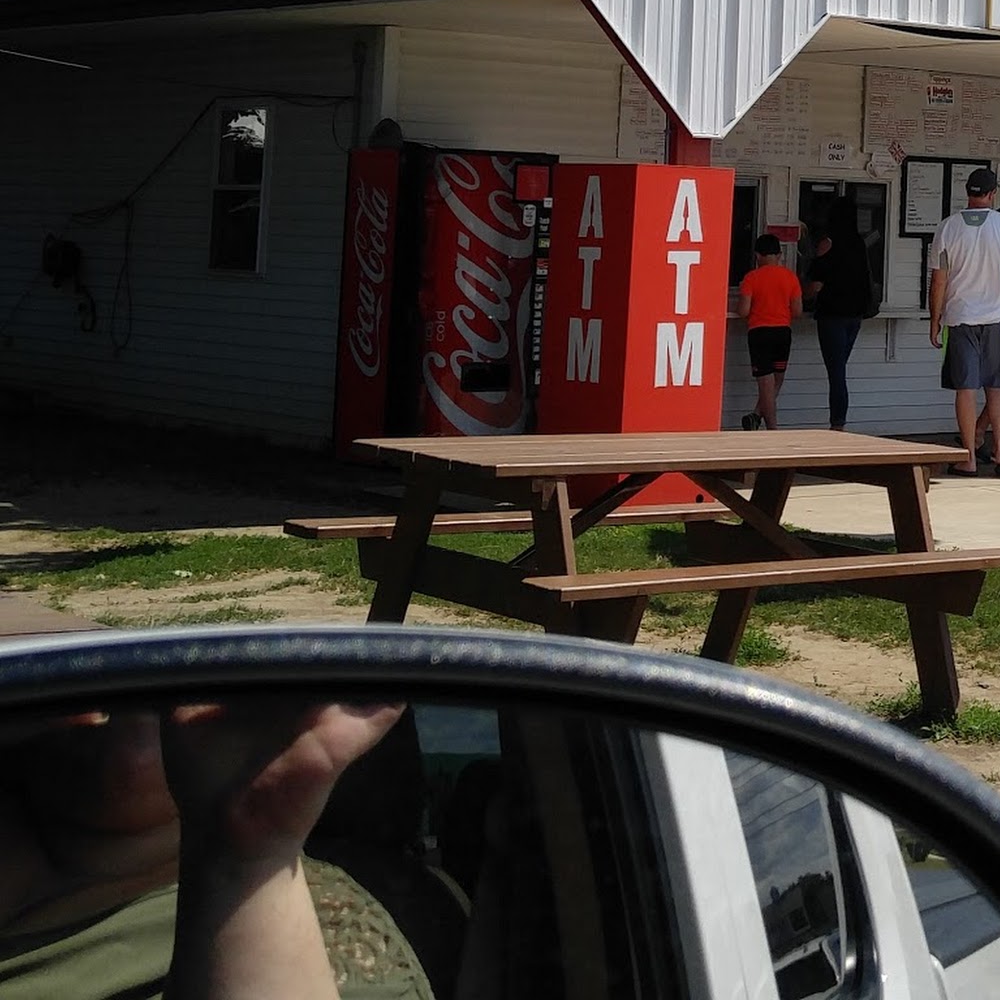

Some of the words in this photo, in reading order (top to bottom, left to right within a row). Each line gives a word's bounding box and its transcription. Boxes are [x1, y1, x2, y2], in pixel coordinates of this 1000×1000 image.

[828, 142, 846, 151] CASH
[828, 153, 846, 161] ONLY
[350, 178, 389, 377] Coca-Cola
[434, 310, 446, 342] cold
[566, 175, 604, 384] ATM
[654, 178, 705, 388] ATM
